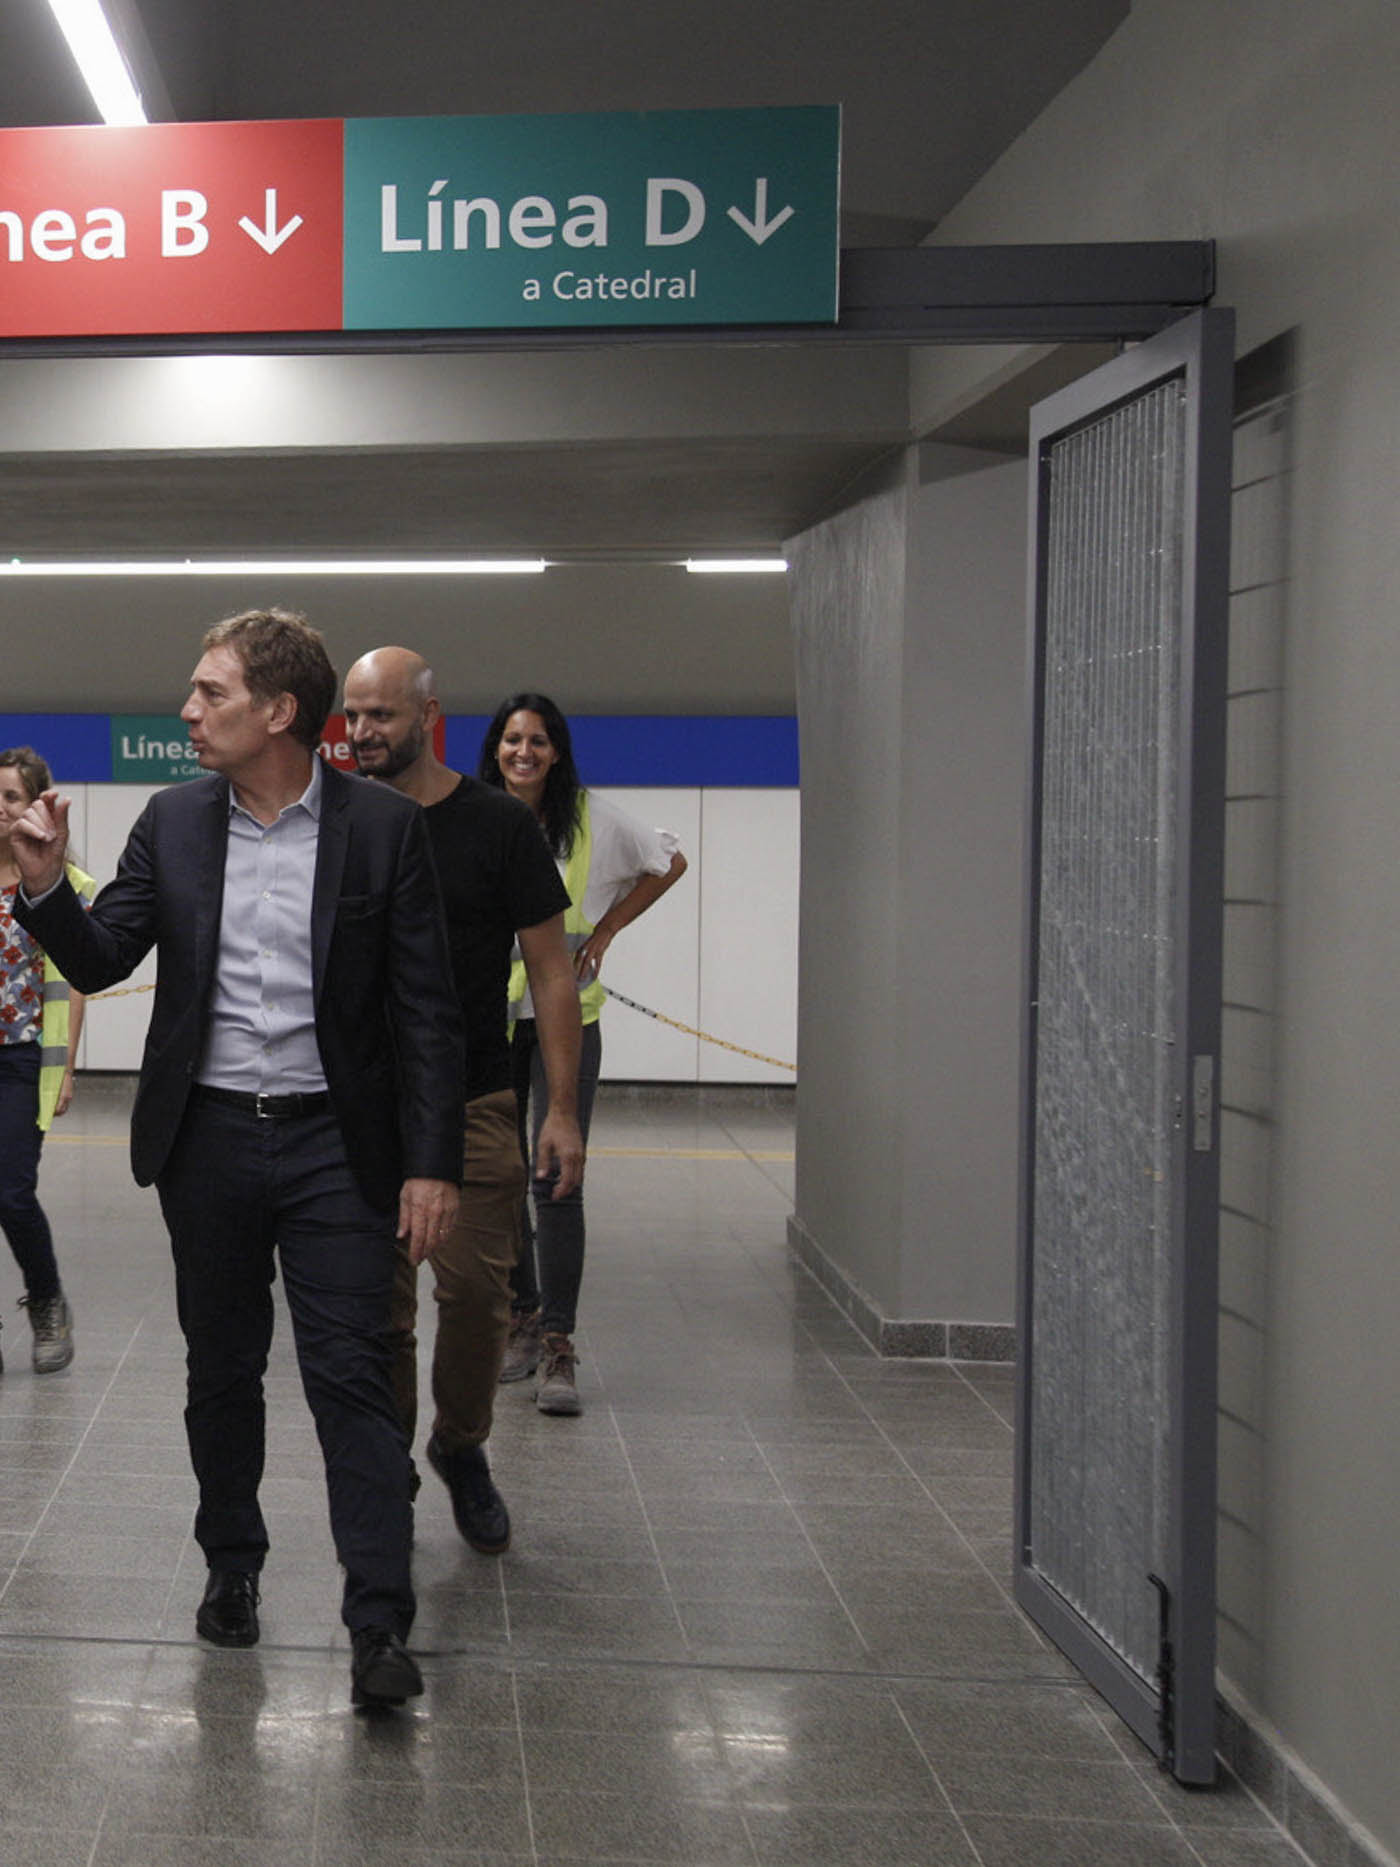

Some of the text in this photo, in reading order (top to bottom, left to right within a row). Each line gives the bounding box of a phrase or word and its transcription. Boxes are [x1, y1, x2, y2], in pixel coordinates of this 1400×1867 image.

[161, 189, 209, 257] B
[381, 178, 706, 252] Línea D
[523, 269, 697, 300] a Catedral
